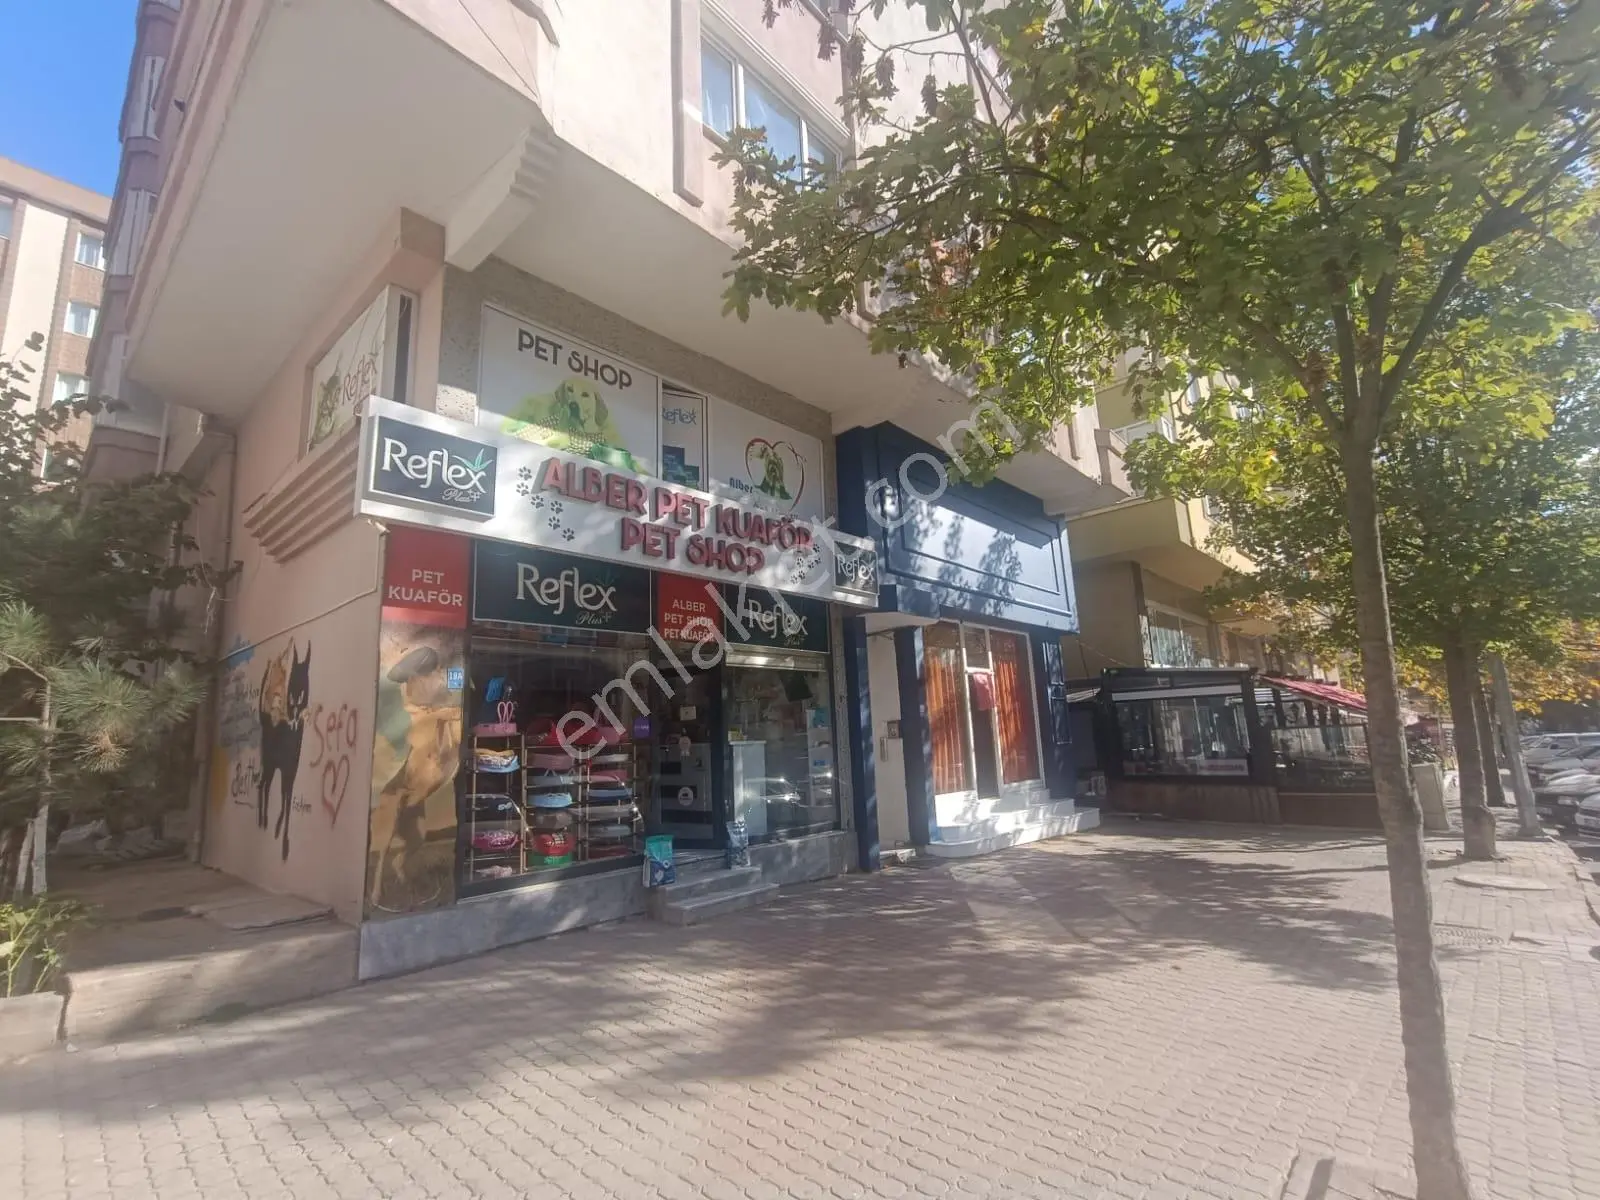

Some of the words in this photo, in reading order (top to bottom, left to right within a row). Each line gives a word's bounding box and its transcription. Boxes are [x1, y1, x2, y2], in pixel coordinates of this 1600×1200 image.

[517, 328, 562, 366] PET
[567, 351, 633, 390] SHOP
[382, 437, 487, 494] Reflex
[539, 457, 647, 516] ALBER
[655, 487, 710, 531] PET
[715, 503, 813, 550] KUAFÖR
[620, 517, 681, 560] PET
[686, 533, 765, 576] SHOP
[411, 568, 445, 584] PET
[837, 554, 876, 582] Reflex
[388, 585, 463, 608] KUAFÖR
[516, 562, 618, 615] Reflex
[672, 599, 706, 612] ALBER
[664, 612, 684, 624] PET
[687, 616, 714, 627] SHOP
[664, 628, 679, 639] PET
[680, 630, 715, 641] KUAFÖR
[748, 598, 809, 639] Reflex
